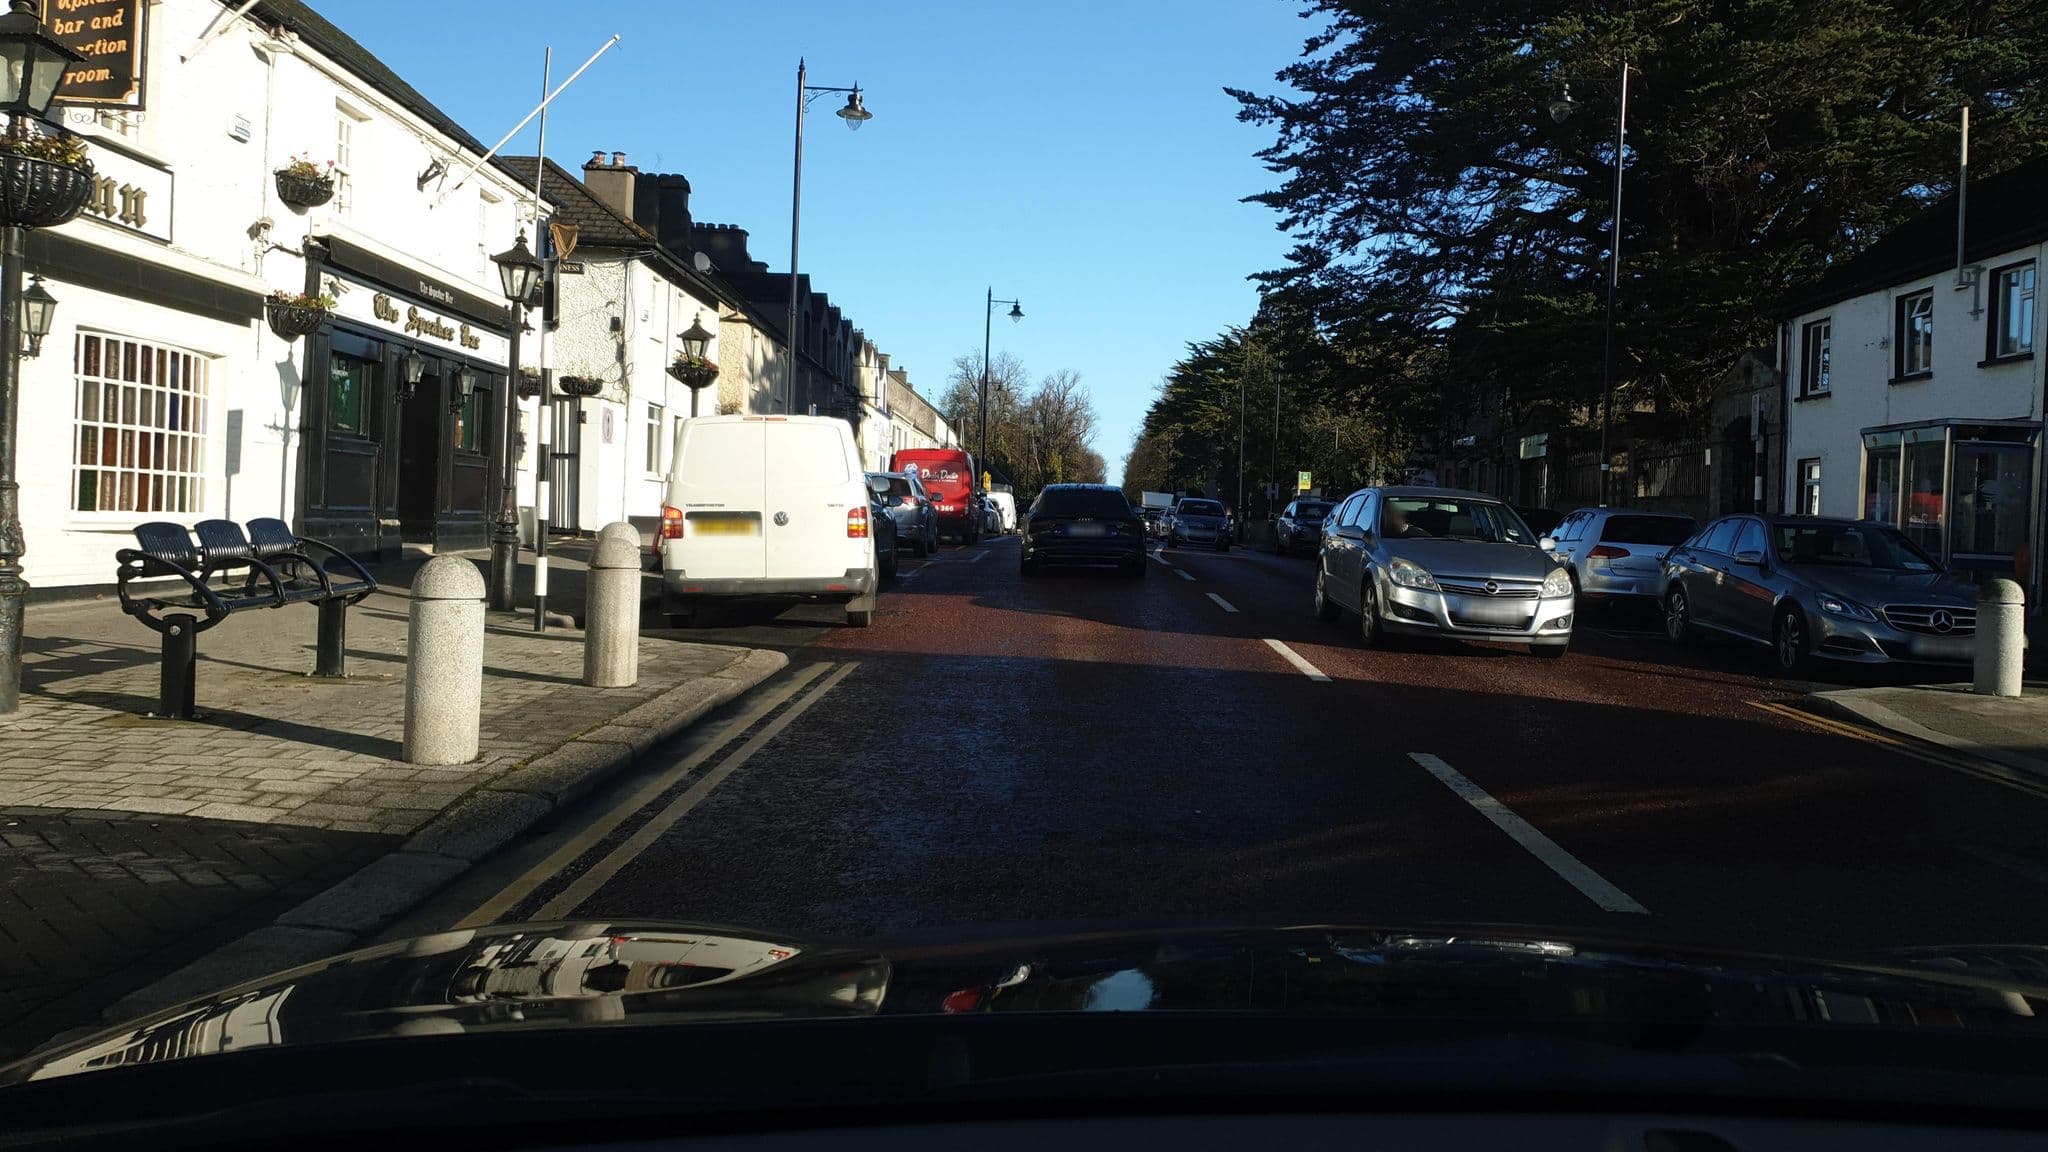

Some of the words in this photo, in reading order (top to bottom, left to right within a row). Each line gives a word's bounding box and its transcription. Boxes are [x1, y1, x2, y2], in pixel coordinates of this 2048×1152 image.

[54, 18, 85, 35] bar
[91, 8, 124, 29] and
[76, 38, 127, 56] ction
[89, 170, 148, 229] nn
